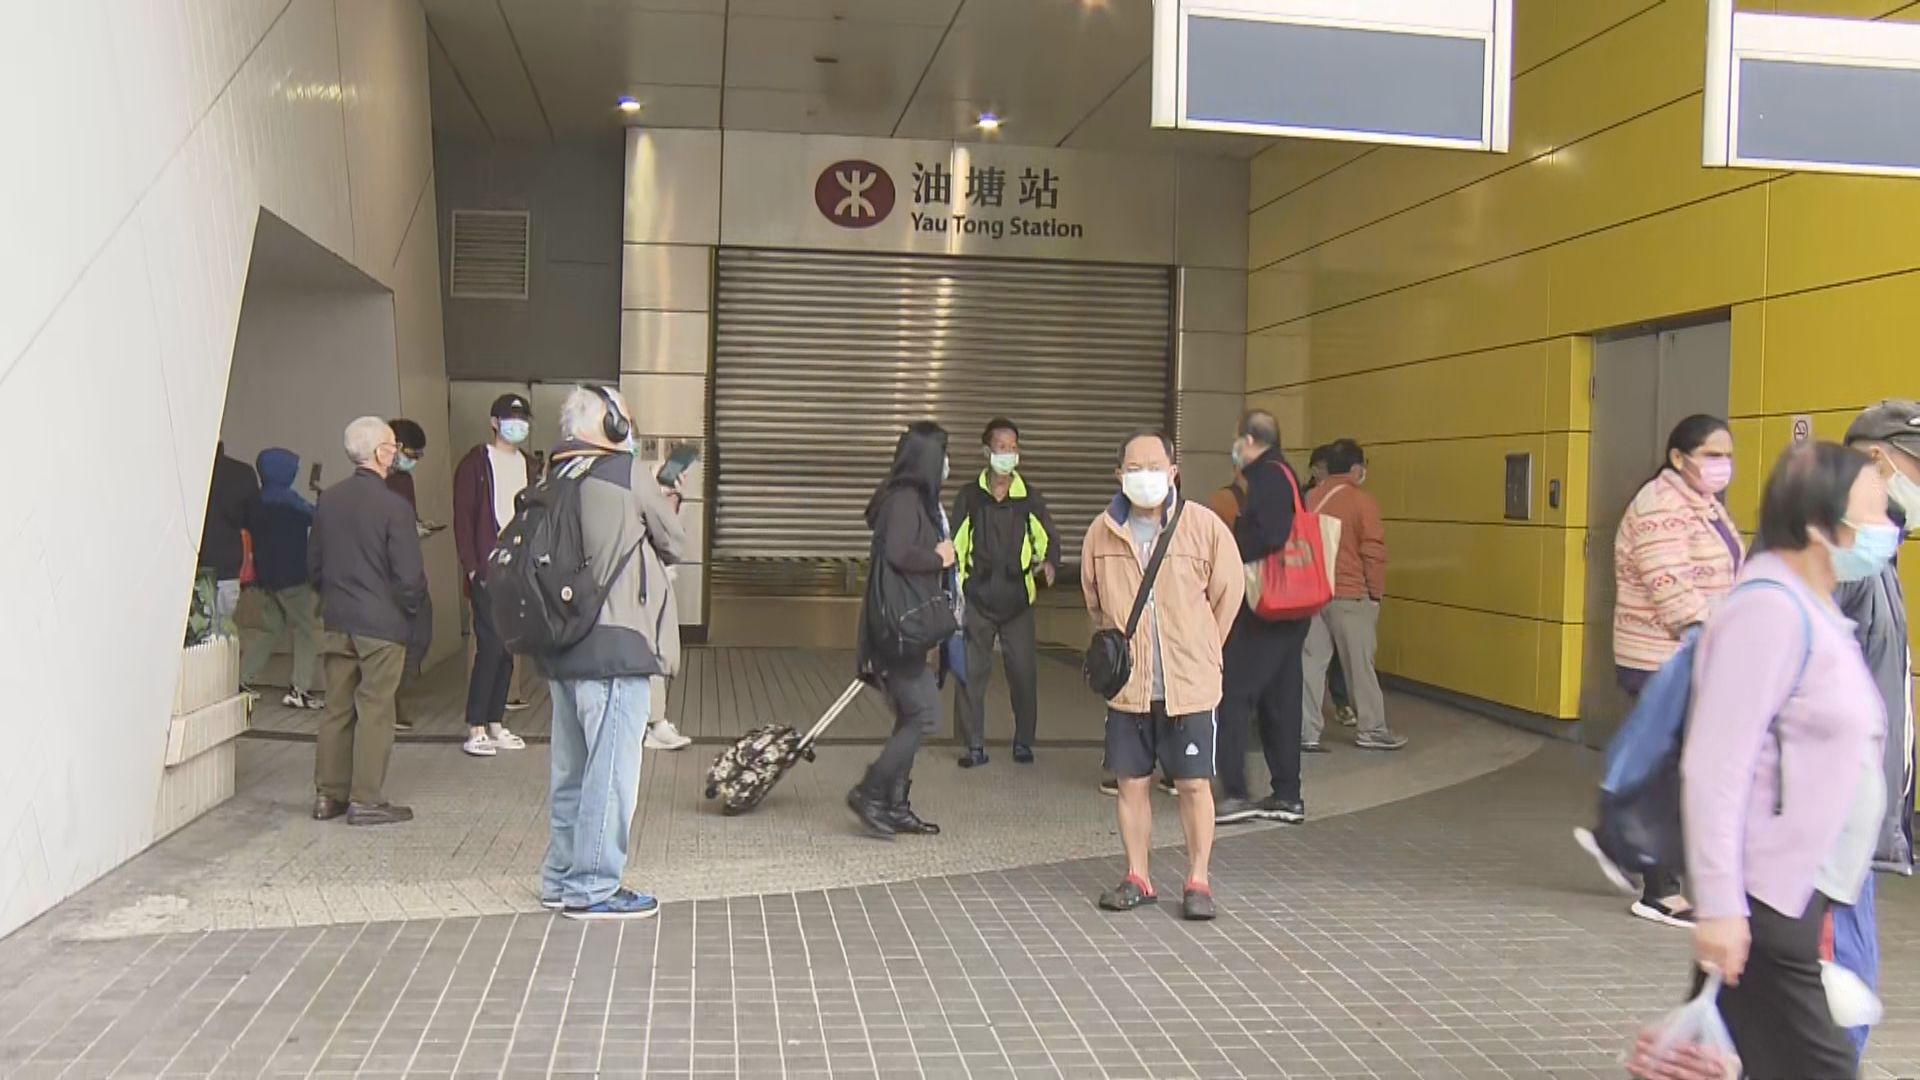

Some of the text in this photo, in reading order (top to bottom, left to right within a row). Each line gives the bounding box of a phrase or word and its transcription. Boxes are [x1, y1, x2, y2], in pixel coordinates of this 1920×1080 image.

[912, 162, 1060, 209] 油塘站
[911, 212, 1083, 239] Yau Tong Station
